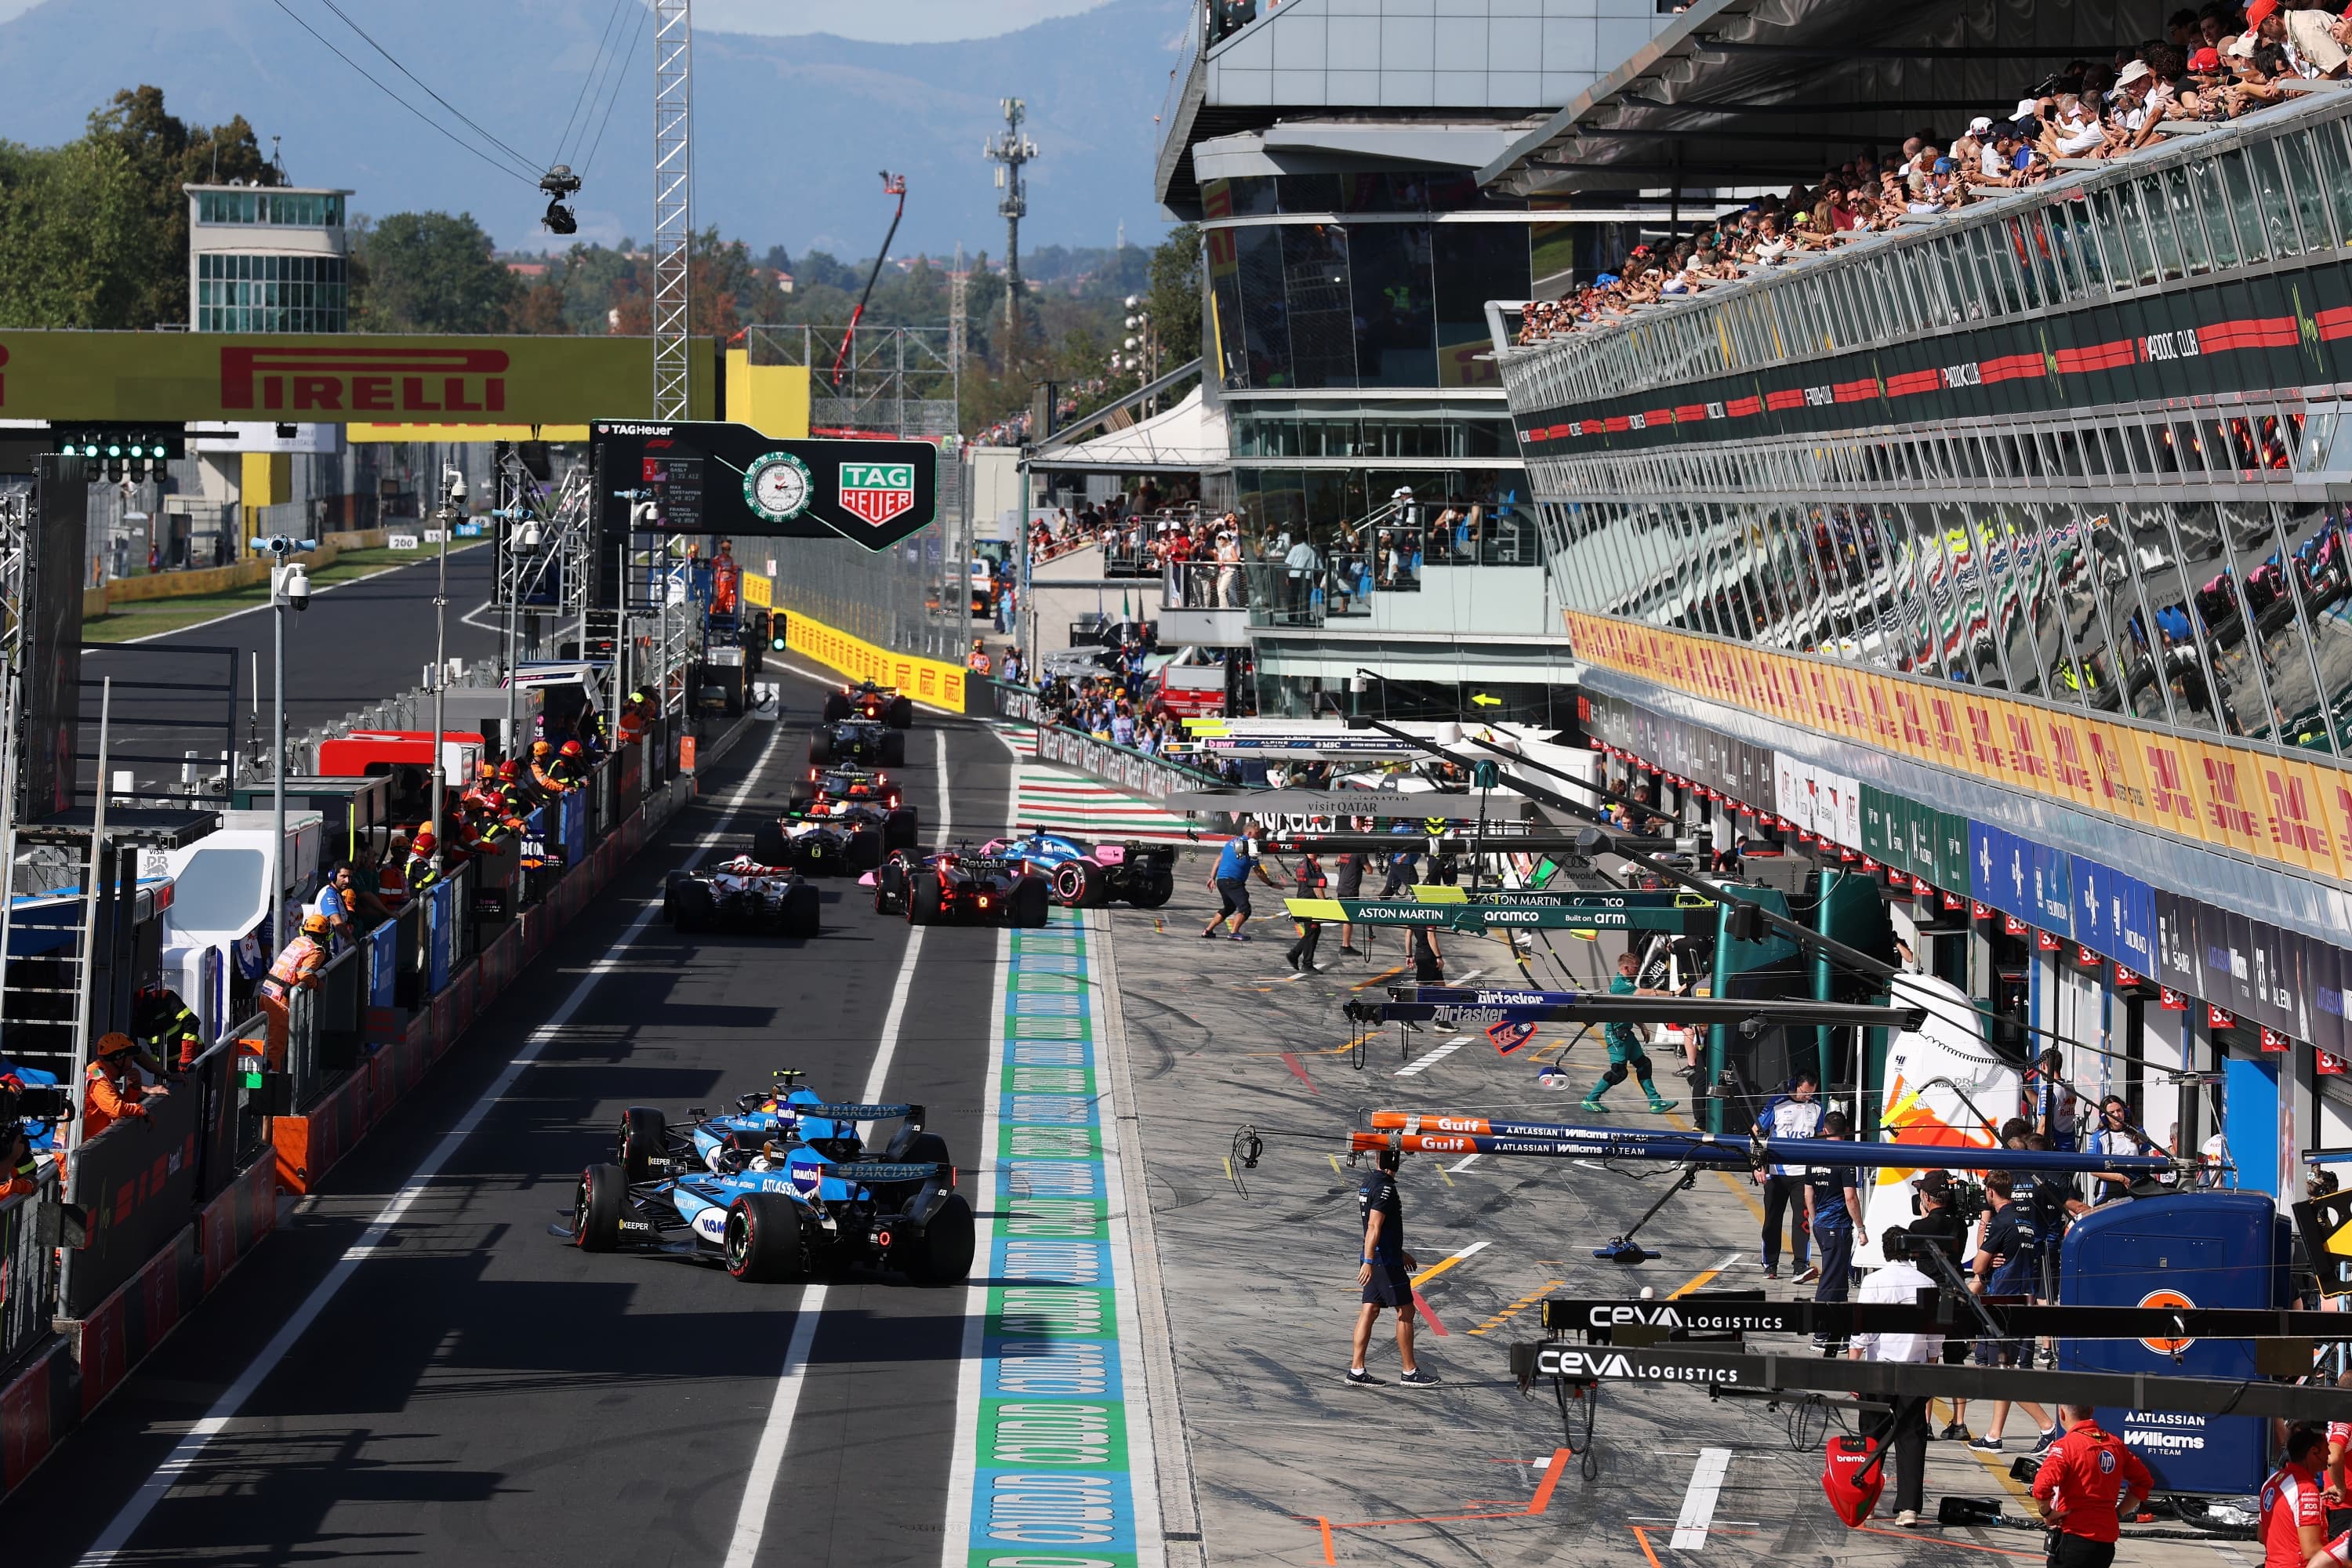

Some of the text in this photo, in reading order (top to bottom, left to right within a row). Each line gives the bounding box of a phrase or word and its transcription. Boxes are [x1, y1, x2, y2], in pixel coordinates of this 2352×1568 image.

[2177, 328, 2198, 357] CLUB
[220, 346, 510, 412] PIRELLI
[645, 466, 652, 474] 1
[845, 467, 908, 487] TAG
[646, 488, 652, 497] 2
[843, 491, 909, 521] HEUER
[394, 538, 413, 548] 200
[1308, 800, 1377, 813] visit QATAR
[521, 841, 544, 856] BOX
[959, 858, 1008, 869] Revolut
[1563, 870, 1597, 880] Revolut
[1519, 896, 1561, 906] MARTIN
[1357, 906, 1444, 920] ASTON MARTIN
[1483, 911, 1540, 922] aramco
[1594, 913, 1626, 924] arm
[1648, 959, 1663, 975] visit
[1476, 990, 1544, 1004] Airtasker
[2163, 985, 2186, 1004] 34
[1431, 1004, 1508, 1022] Airtasker
[2212, 1003, 2234, 1022] 33
[2264, 1025, 2287, 1046] 32
[831, 1106, 899, 1117] BARCLAYS
[1437, 1117, 1479, 1133] Gulf
[1512, 1127, 1559, 1137] ATLASSIAN
[1565, 1128, 1609, 1141] Williams
[1421, 1136, 1465, 1152] Gulf
[1501, 1142, 1550, 1152] ATLASSIAN
[1556, 1144, 1603, 1155] Williams
[1619, 1146, 1646, 1156] TEAM
[651, 1157, 671, 1167] KEEPER
[793, 1168, 818, 1181] KOMATSU
[855, 1166, 925, 1178] BARCLAYS
[624, 1221, 649, 1231] KEEPER
[1002, 1240, 1101, 1283] aramco
[1000, 1288, 1102, 1334] aramco
[1687, 1316, 1784, 1330] LOGISTICS
[996, 1341, 1108, 1395] aramco
[1638, 1367, 1738, 1383] LOGISTICS
[2135, 1411, 2206, 1427] ATLASSIAN
[992, 1403, 1111, 1465] aramco
[2124, 1430, 2205, 1450] Williams
[1836, 1454, 1866, 1465] bremb
[2100, 1453, 2114, 1472] hp
[986, 1474, 1116, 1544] aramco
